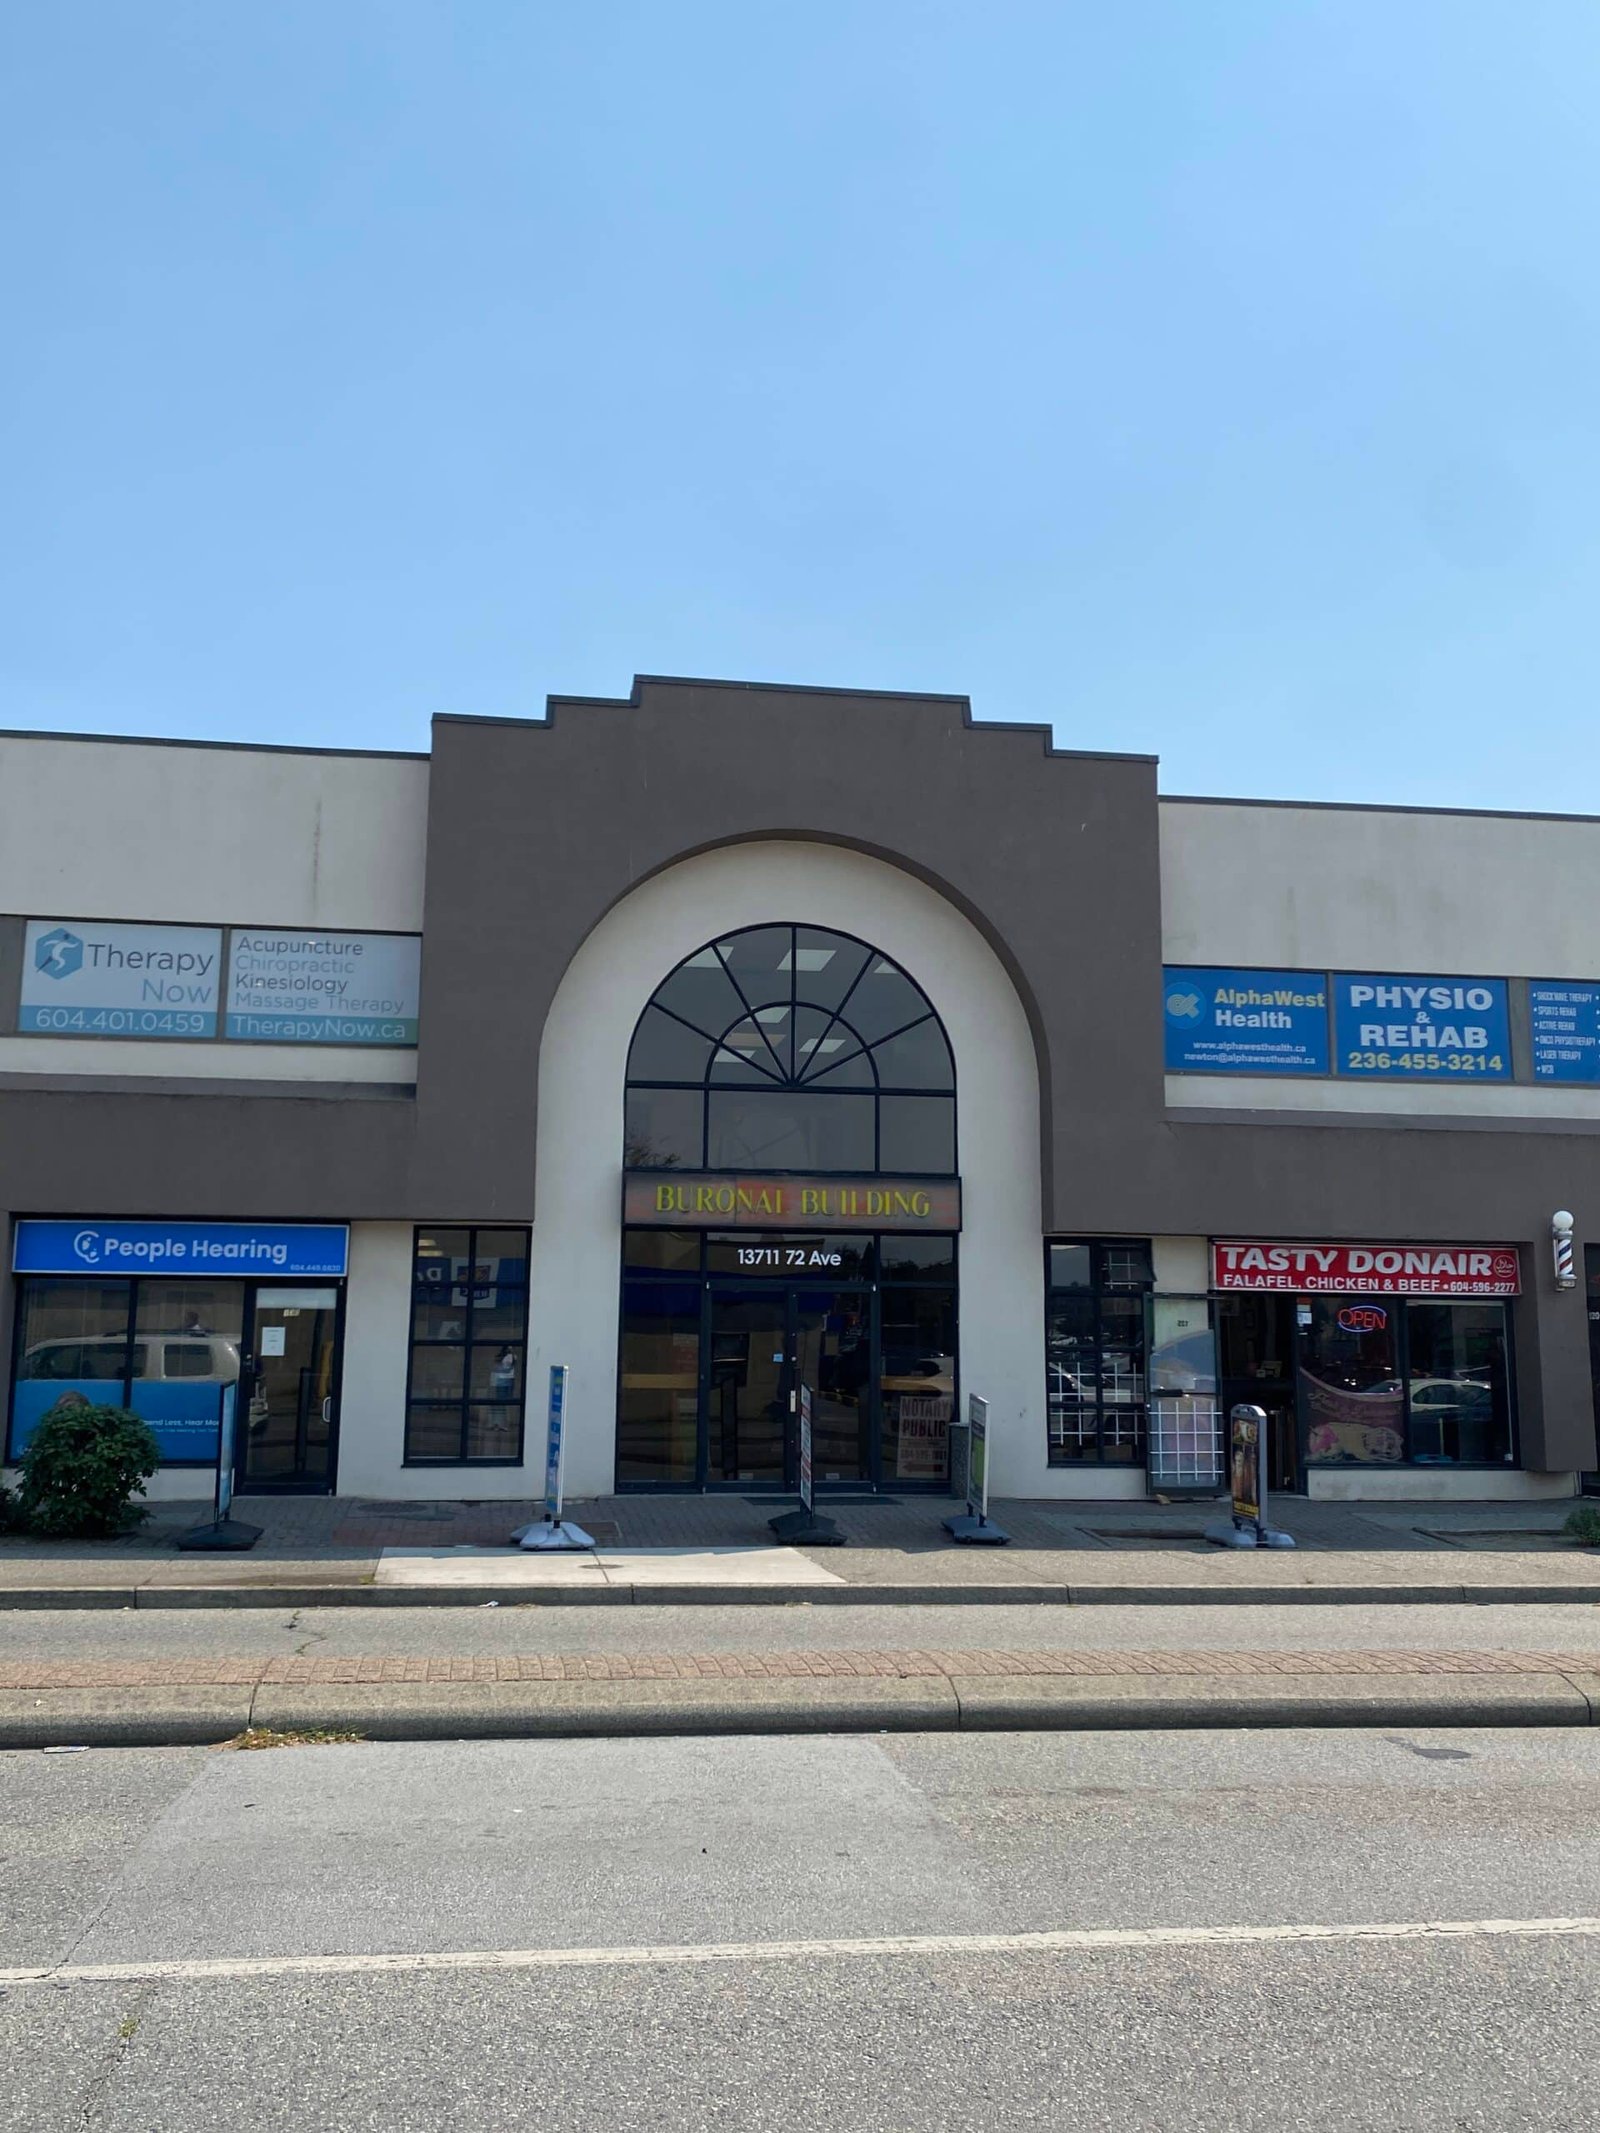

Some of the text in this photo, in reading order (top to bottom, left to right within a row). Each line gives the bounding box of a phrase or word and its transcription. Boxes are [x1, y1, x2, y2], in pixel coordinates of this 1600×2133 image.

[238, 936, 363, 956] Acupuncture
[88, 943, 214, 976] Therapy
[235, 954, 355, 975] Chiropractic
[142, 978, 212, 1004] Now
[236, 973, 348, 995] Kinesiology
[235, 992, 404, 1015] Massage Therapy
[1214, 988, 1325, 1008] AlphaWest
[1351, 985, 1493, 1011] PHYSIO
[36, 1008, 204, 1033] 604.401.0459
[233, 1015, 406, 1039] TherapyNow.ca
[1215, 1009, 1292, 1029] Health
[1415, 1011, 1431, 1024] &
[1193, 1041, 1306, 1053] www.alphawesthealth.ca
[1360, 1024, 1488, 1049] REHAB
[1184, 1053, 1316, 1065] newton@alphawesthealth.ca
[1348, 1052, 1502, 1071] 236-455-3214
[801, 1188, 930, 1217] BUILDING
[104, 1238, 288, 1265] People Hearing
[737, 1249, 842, 1266] 13711 72 Ave
[1220, 1247, 1493, 1276] TASTY DONAIR
[1223, 1274, 1515, 1293] FALAFEL, CHICKEN & BEEF 604-596-2277
[1338, 1308, 1386, 1329] OPEN
[901, 1398, 950, 1417] NOTARY
[902, 1420, 947, 1438] PUBLIC
